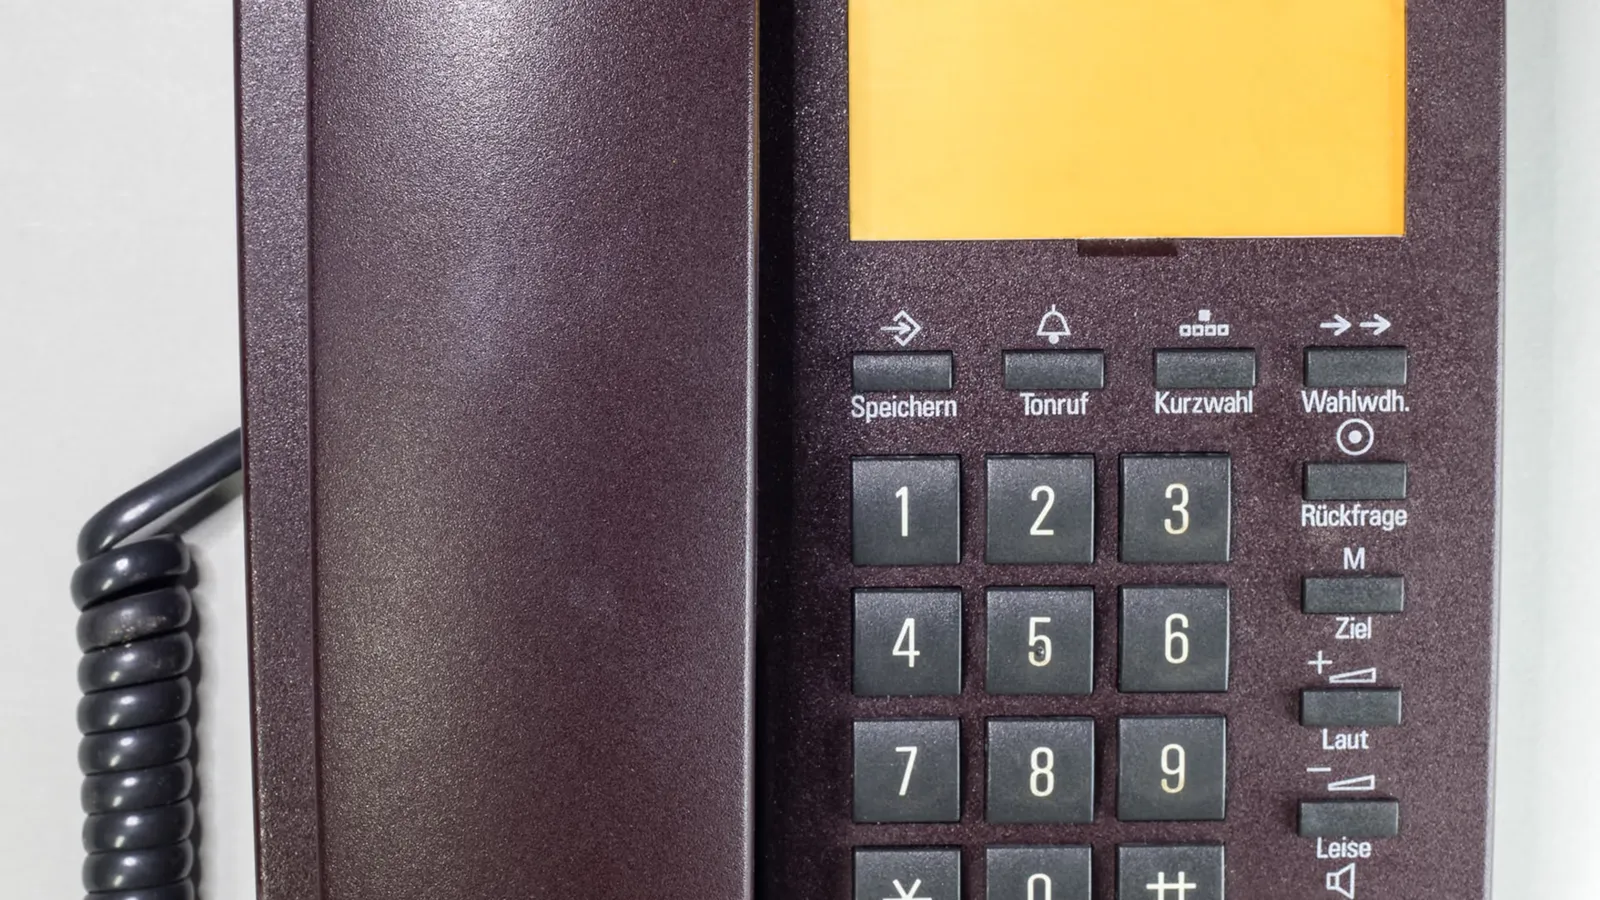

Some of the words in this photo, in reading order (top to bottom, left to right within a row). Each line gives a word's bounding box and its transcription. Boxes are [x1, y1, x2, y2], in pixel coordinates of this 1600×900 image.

[851, 394, 958, 424] Speichern
[1019, 391, 1089, 416] Tonruf
[1154, 389, 1254, 415] Kurzwahl
[1300, 388, 1410, 414] Wahlwdh.
[894, 485, 909, 537] 1
[1029, 484, 1056, 536] 2
[1163, 482, 1190, 535] 3
[1301, 502, 1409, 532] Rückfrage
[1343, 546, 1366, 570] M
[891, 616, 921, 668] 4
[1028, 616, 1053, 667] 5
[1164, 612, 1190, 665] 6
[1334, 615, 1373, 640] Ziel
[1321, 727, 1370, 751] Laut
[894, 745, 918, 796] 7
[1029, 746, 1055, 798] 8
[1160, 743, 1186, 794] 9
[1316, 837, 1373, 859] Leise
